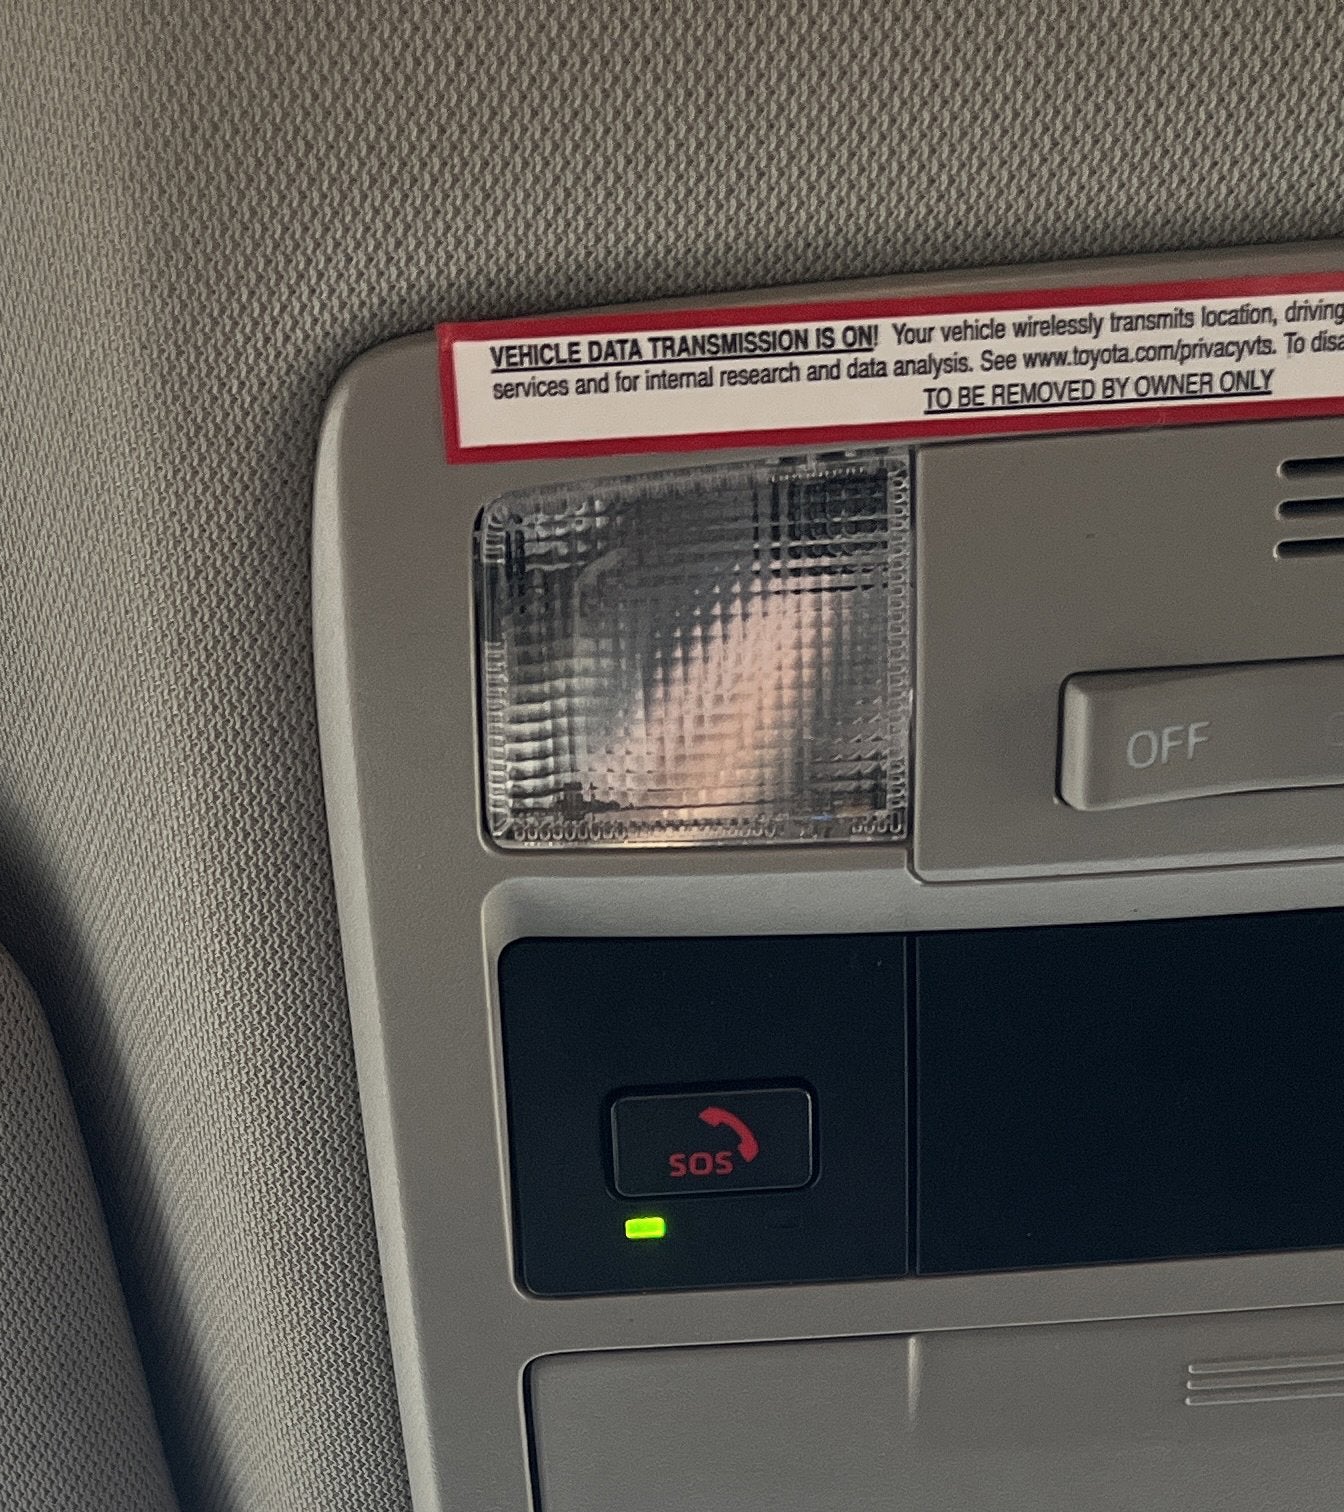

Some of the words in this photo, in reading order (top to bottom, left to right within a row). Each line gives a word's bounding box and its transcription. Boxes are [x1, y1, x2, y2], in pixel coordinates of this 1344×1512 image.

[490, 341, 581, 368] VEHICLE
[587, 338, 643, 363] DATA
[648, 328, 809, 360] TRANSMISSION
[815, 327, 835, 350] IS
[842, 323, 878, 348] ON!
[892, 323, 935, 346] Your
[941, 317, 1006, 342] vehicle
[1012, 312, 1105, 340] wirelessly
[1110, 307, 1194, 332] transmits
[1201, 304, 1278, 328] location,
[492, 376, 570, 400] services
[575, 372, 610, 396] and
[615, 371, 641, 393] for
[644, 366, 713, 391] internal
[719, 362, 801, 388] research
[806, 359, 841, 382] and
[847, 357, 889, 380] data
[894, 352, 974, 380] analysis.
[980, 349, 1017, 372] See
[1023, 337, 1277, 370] www.toyota.com/privacyvts.
[1284, 331, 1306, 354] To
[923, 386, 952, 410] TO
[957, 384, 985, 408] BE
[991, 378, 1096, 406] REMOVED
[1102, 376, 1131, 399] BY
[1134, 371, 1213, 398] OWNER
[1219, 368, 1276, 393] ONLY
[1126, 721, 1211, 770] OFF
[668, 1150, 734, 1178] SOS
